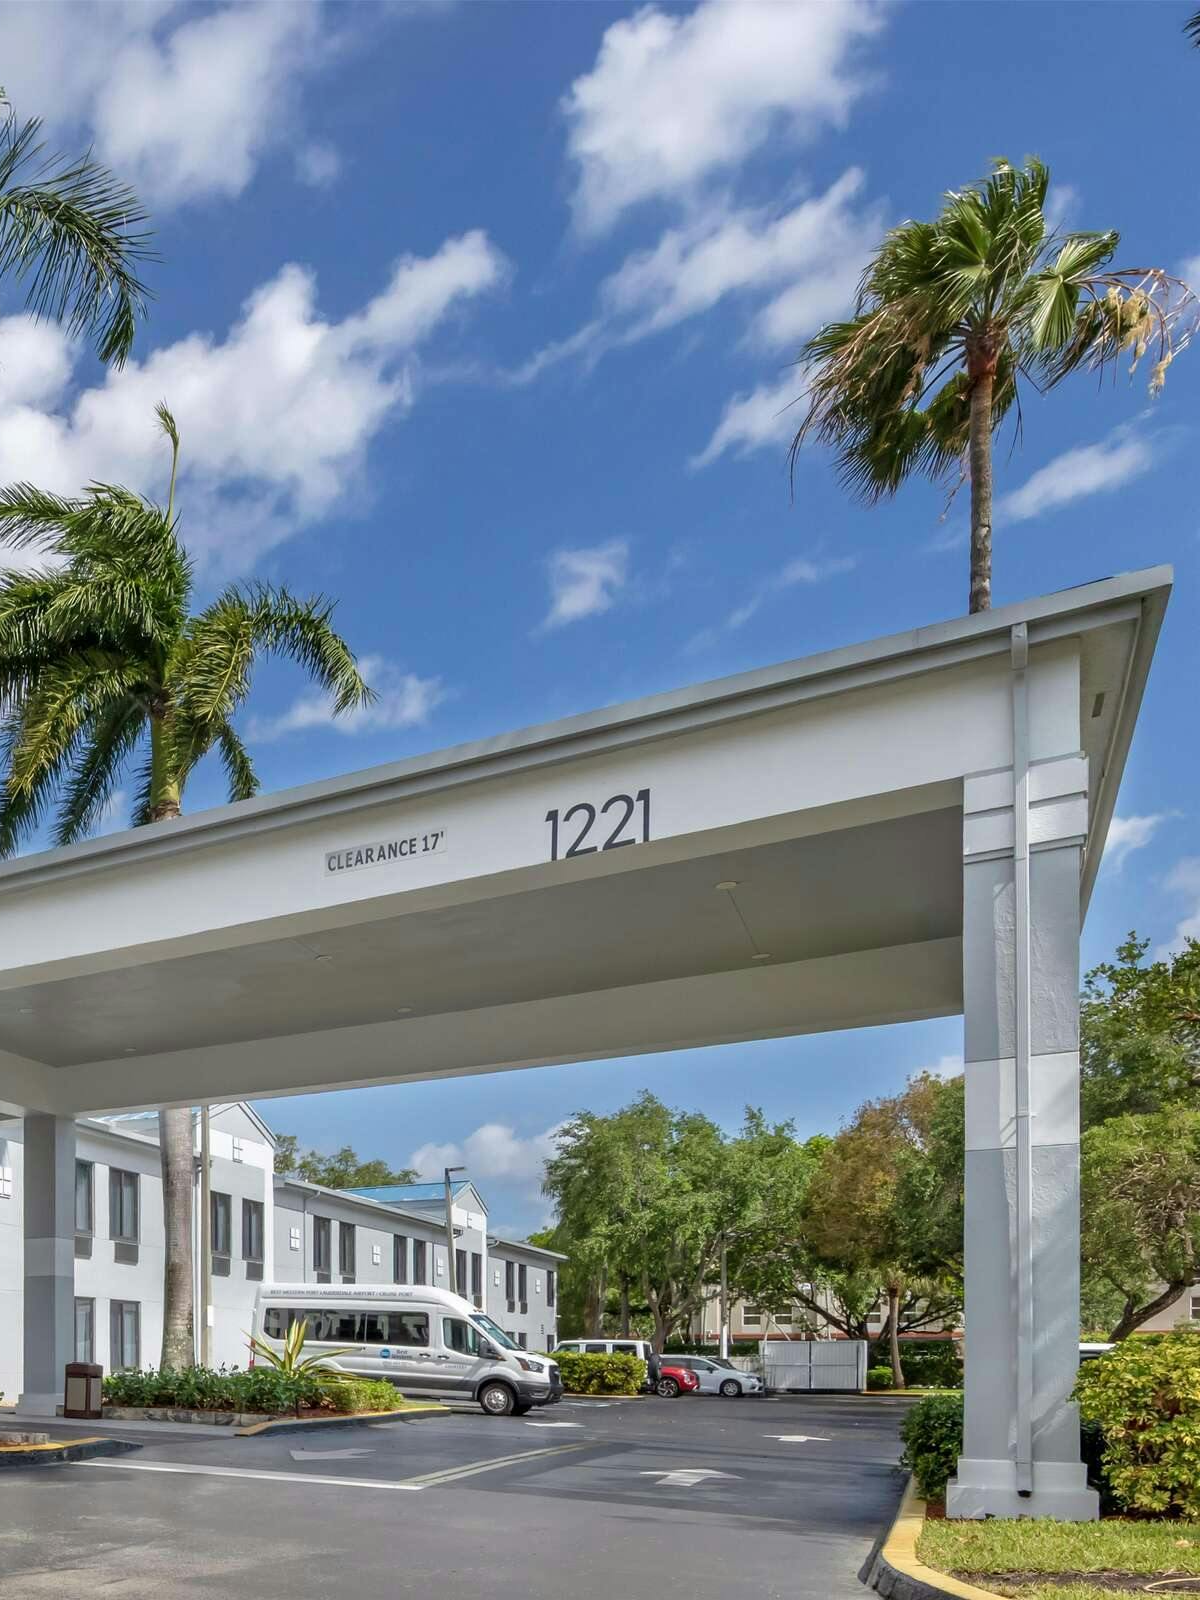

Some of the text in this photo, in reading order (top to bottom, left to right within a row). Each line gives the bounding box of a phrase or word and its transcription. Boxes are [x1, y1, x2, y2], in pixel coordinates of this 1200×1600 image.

[327, 831, 444, 872] CLEARANCE 17'
[545, 788, 650, 862] 1221
